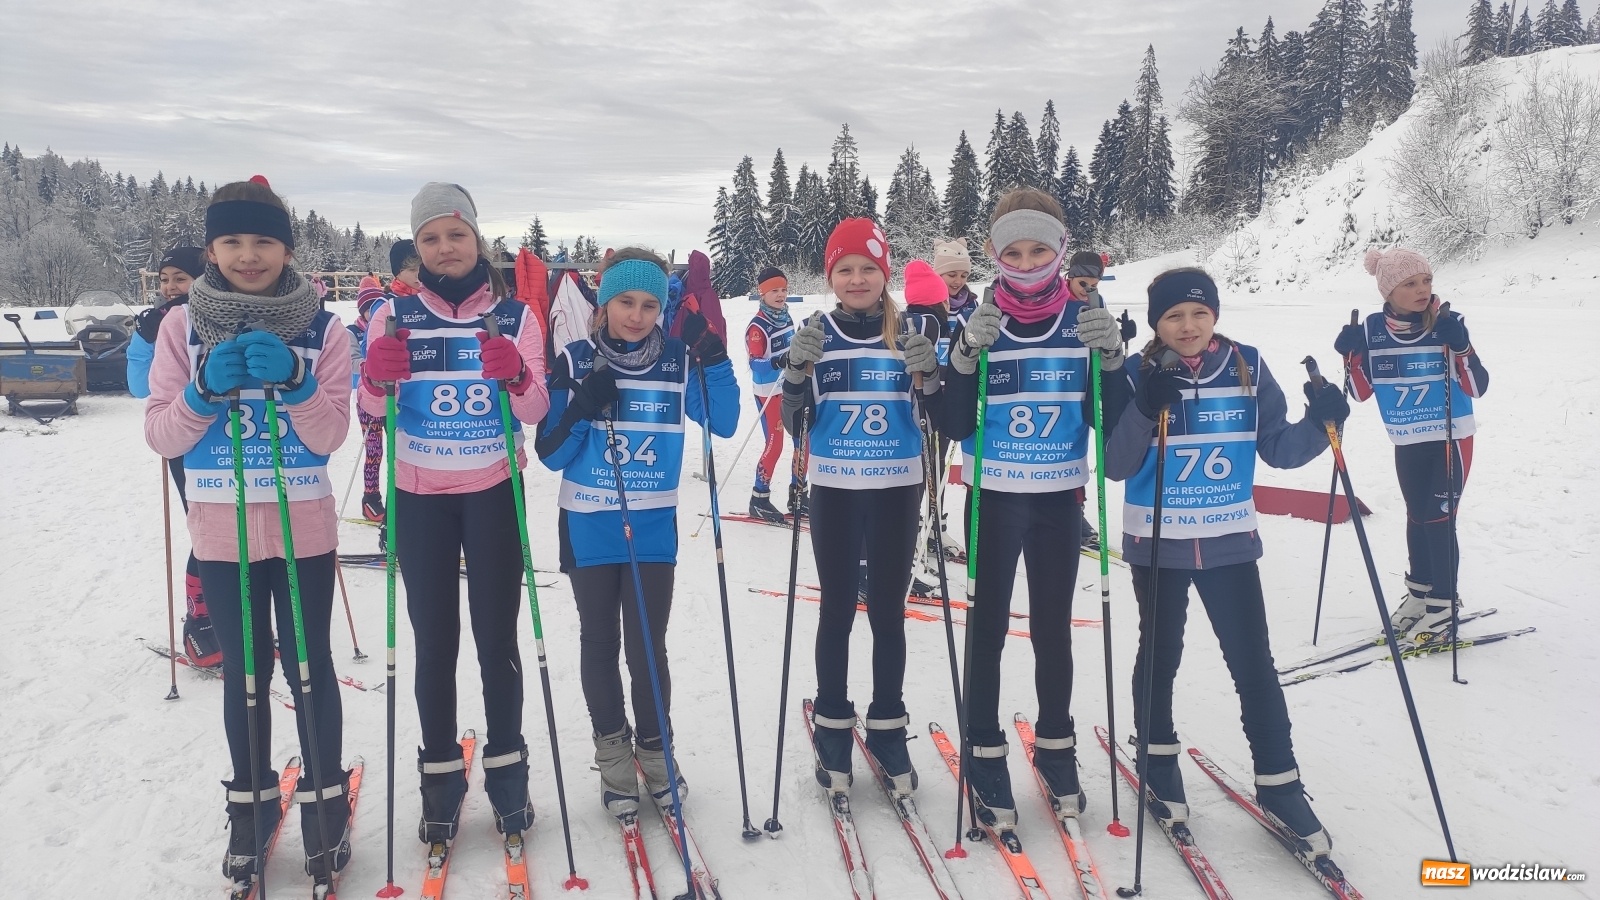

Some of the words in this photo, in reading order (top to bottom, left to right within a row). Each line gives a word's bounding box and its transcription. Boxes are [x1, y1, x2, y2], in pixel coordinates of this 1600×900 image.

[430, 383, 493, 417] 88
[1395, 384, 1430, 408] 77
[1397, 406, 1443, 416] REGIONALNE
[224, 402, 290, 440] 85
[422, 419, 437, 429] LIGI
[440, 419, 501, 430] REGIONALNE
[840, 404, 889, 436] 78
[1008, 405, 1061, 439] 87
[427, 430, 460, 438] GRUPY
[464, 429, 497, 438] AZOTY
[1413, 424, 1456, 434] IGRZYSA
[829, 438, 842, 446] LIGI
[993, 440, 1010, 448] LIGI
[1012, 442, 1073, 451] REGIONALNE
[211, 446, 231, 454] LIGI
[232, 446, 305, 454] EGIONLNE
[409, 441, 431, 454] BIEG
[436, 446, 454, 456] NA
[460, 442, 506, 455] IGRZYSK
[604, 434, 657, 467] 84
[258, 457, 297, 465] AZTY
[999, 452, 1032, 461] GRUPY
[1035, 453, 1067, 461] AZOTY
[818, 464, 837, 474] BIEG
[841, 467, 856, 476] NA
[861, 466, 909, 476] IGRZYSKA
[1175, 446, 1233, 482] 76
[592, 468, 608, 477] LIGI
[610, 470, 665, 478] RGIONALNE
[1008, 471, 1025, 479] NA
[1031, 467, 1081, 480] IGRZYSKA
[197, 478, 222, 488] BIEG
[255, 475, 320, 487] IGRYSKA
[597, 478, 628, 487] GRUY
[631, 481, 659, 489] AZOTY
[1182, 482, 1242, 495] REGIONALNE
[575, 492, 600, 502] BIEG
[1168, 497, 1203, 506] GRUPY
[1206, 494, 1235, 504] AZOTY
[1146, 514, 1172, 524] BEG
[1179, 516, 1197, 524] NA
[1203, 508, 1249, 524] IGRZYSKA
[1295, 848, 1333, 892] ATOMIC
